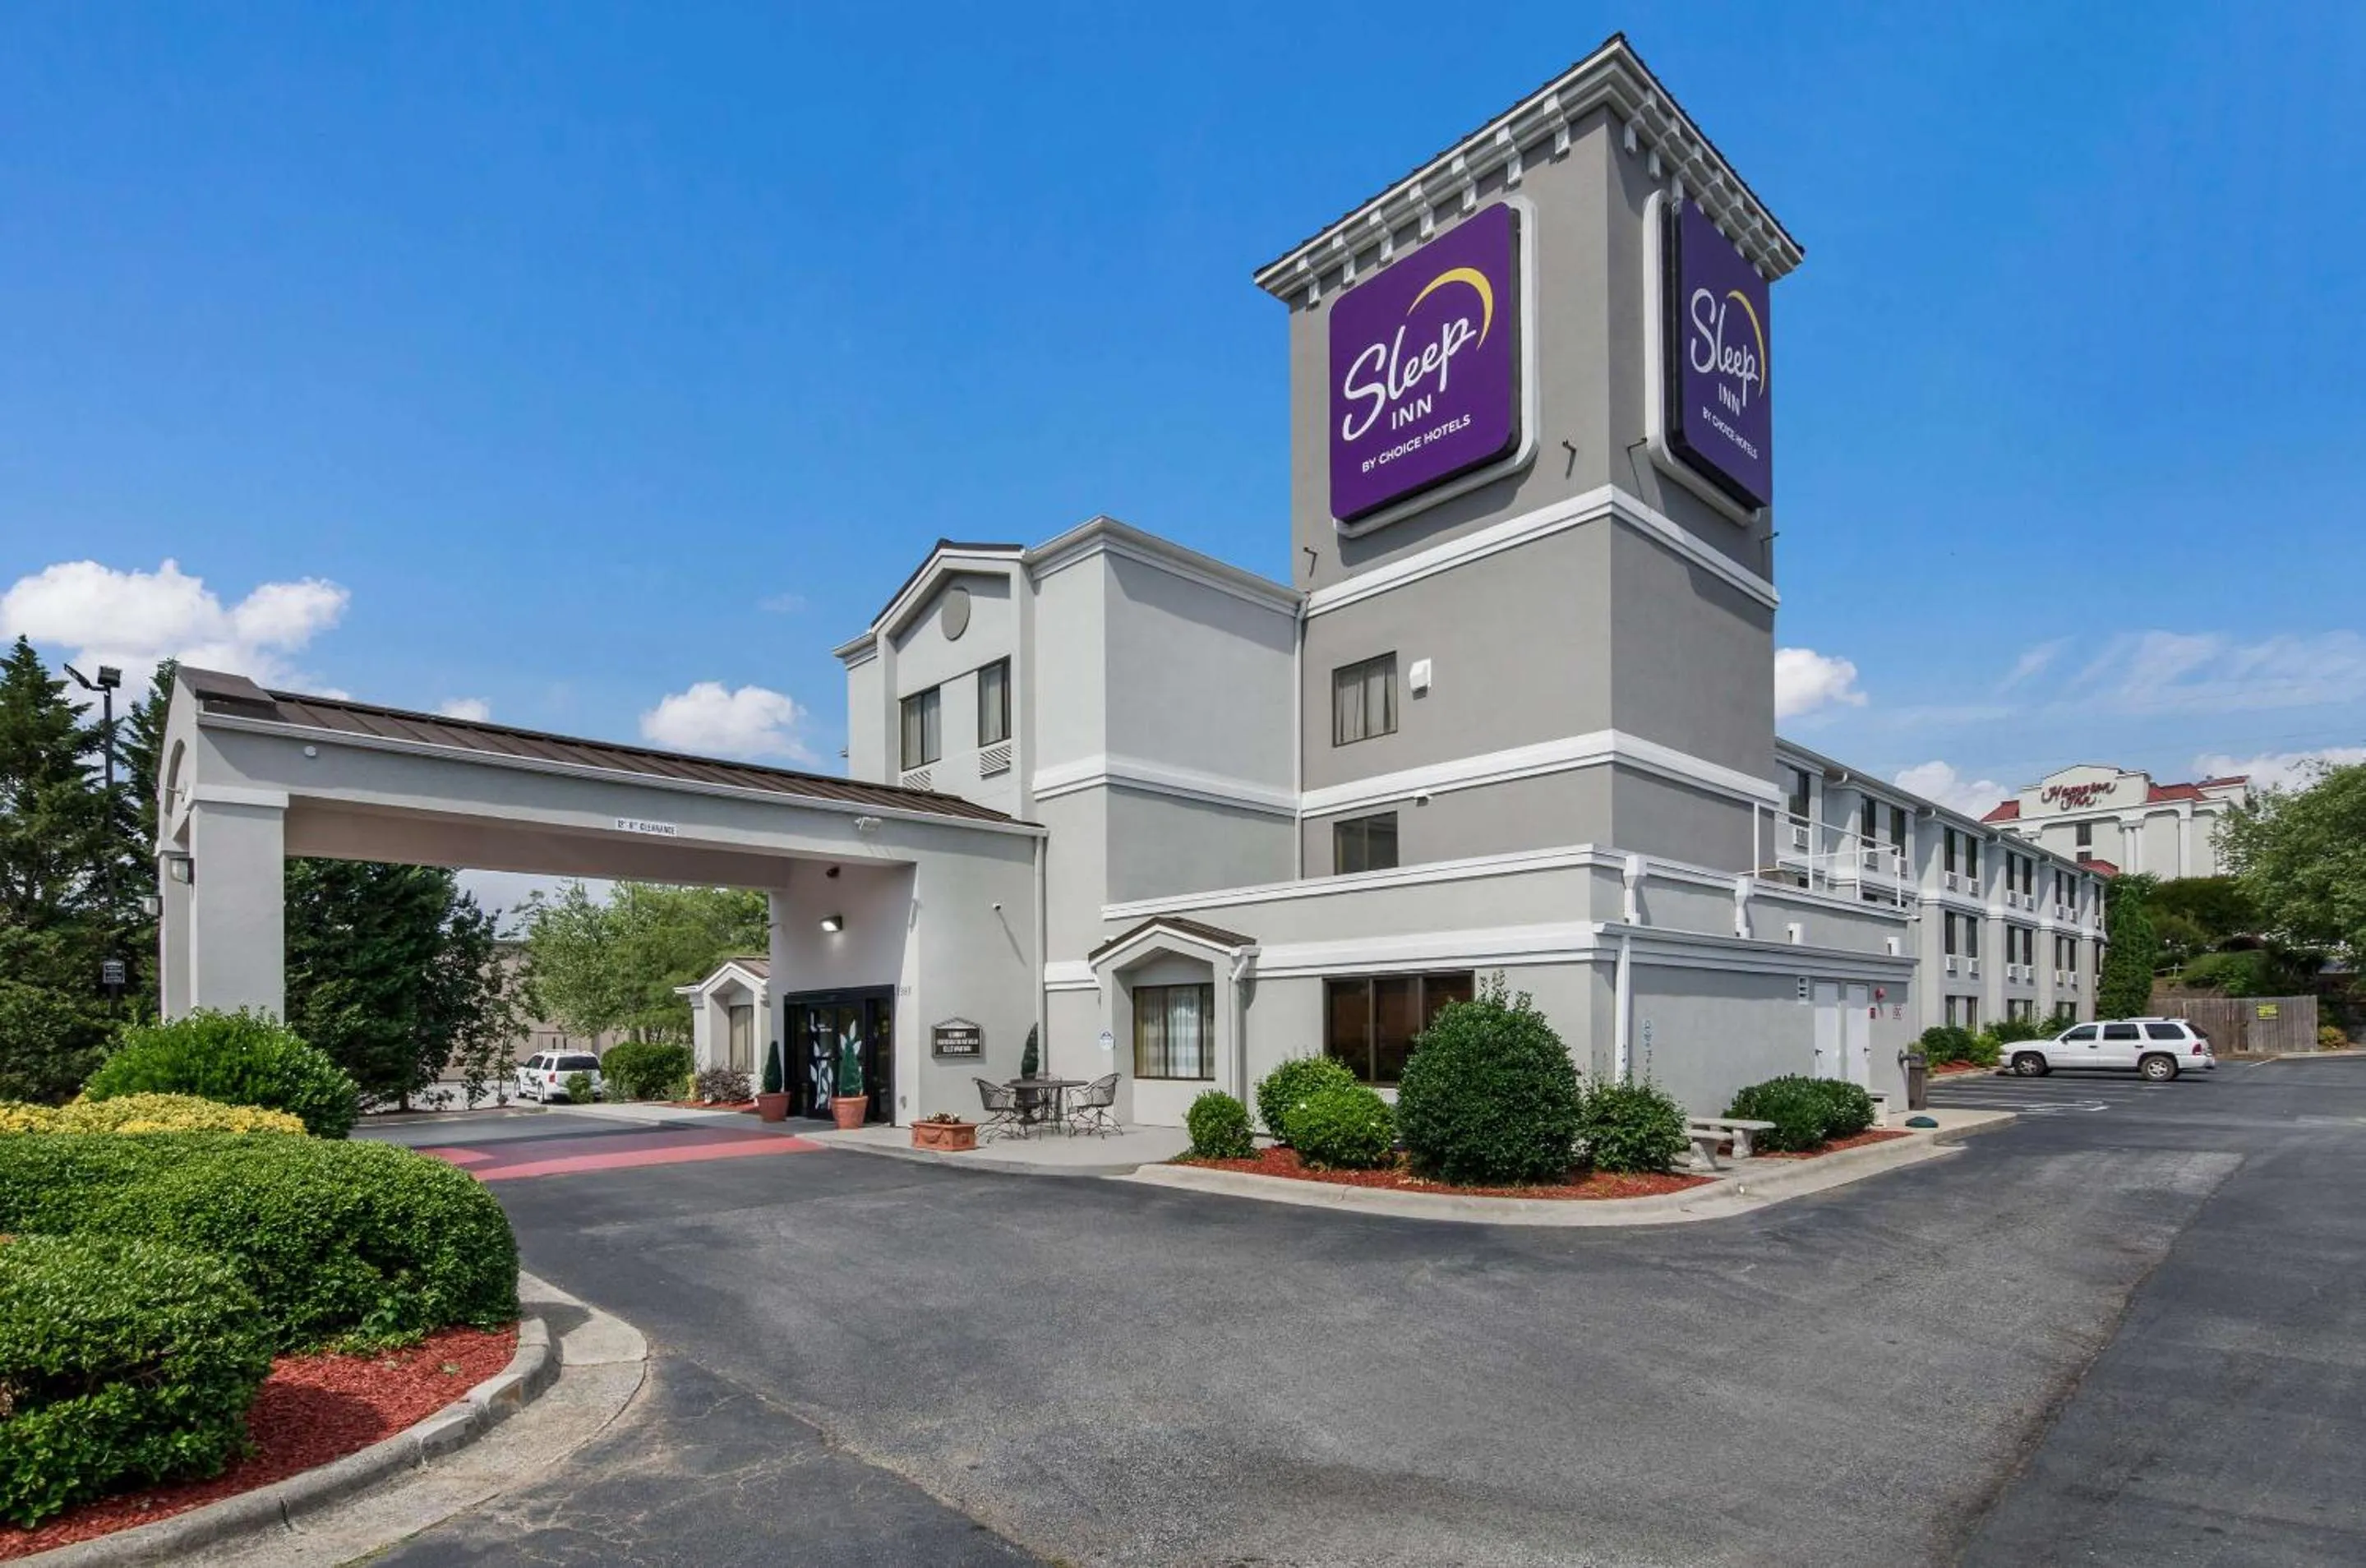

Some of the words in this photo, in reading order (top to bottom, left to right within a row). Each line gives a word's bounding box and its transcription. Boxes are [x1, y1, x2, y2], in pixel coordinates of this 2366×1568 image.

[1690, 288, 1759, 407] Sleep
[1341, 316, 1477, 442] Sleep
[1718, 382, 1741, 417] INN
[1391, 394, 1432, 430] INN
[1703, 406, 1712, 421] BY
[1712, 415, 1735, 441] CHOICE
[1735, 434, 1758, 459] HOTELS
[1362, 457, 1377, 473] BY
[1379, 436, 1422, 464] CHOICE
[1423, 414, 1471, 444] HOTELS
